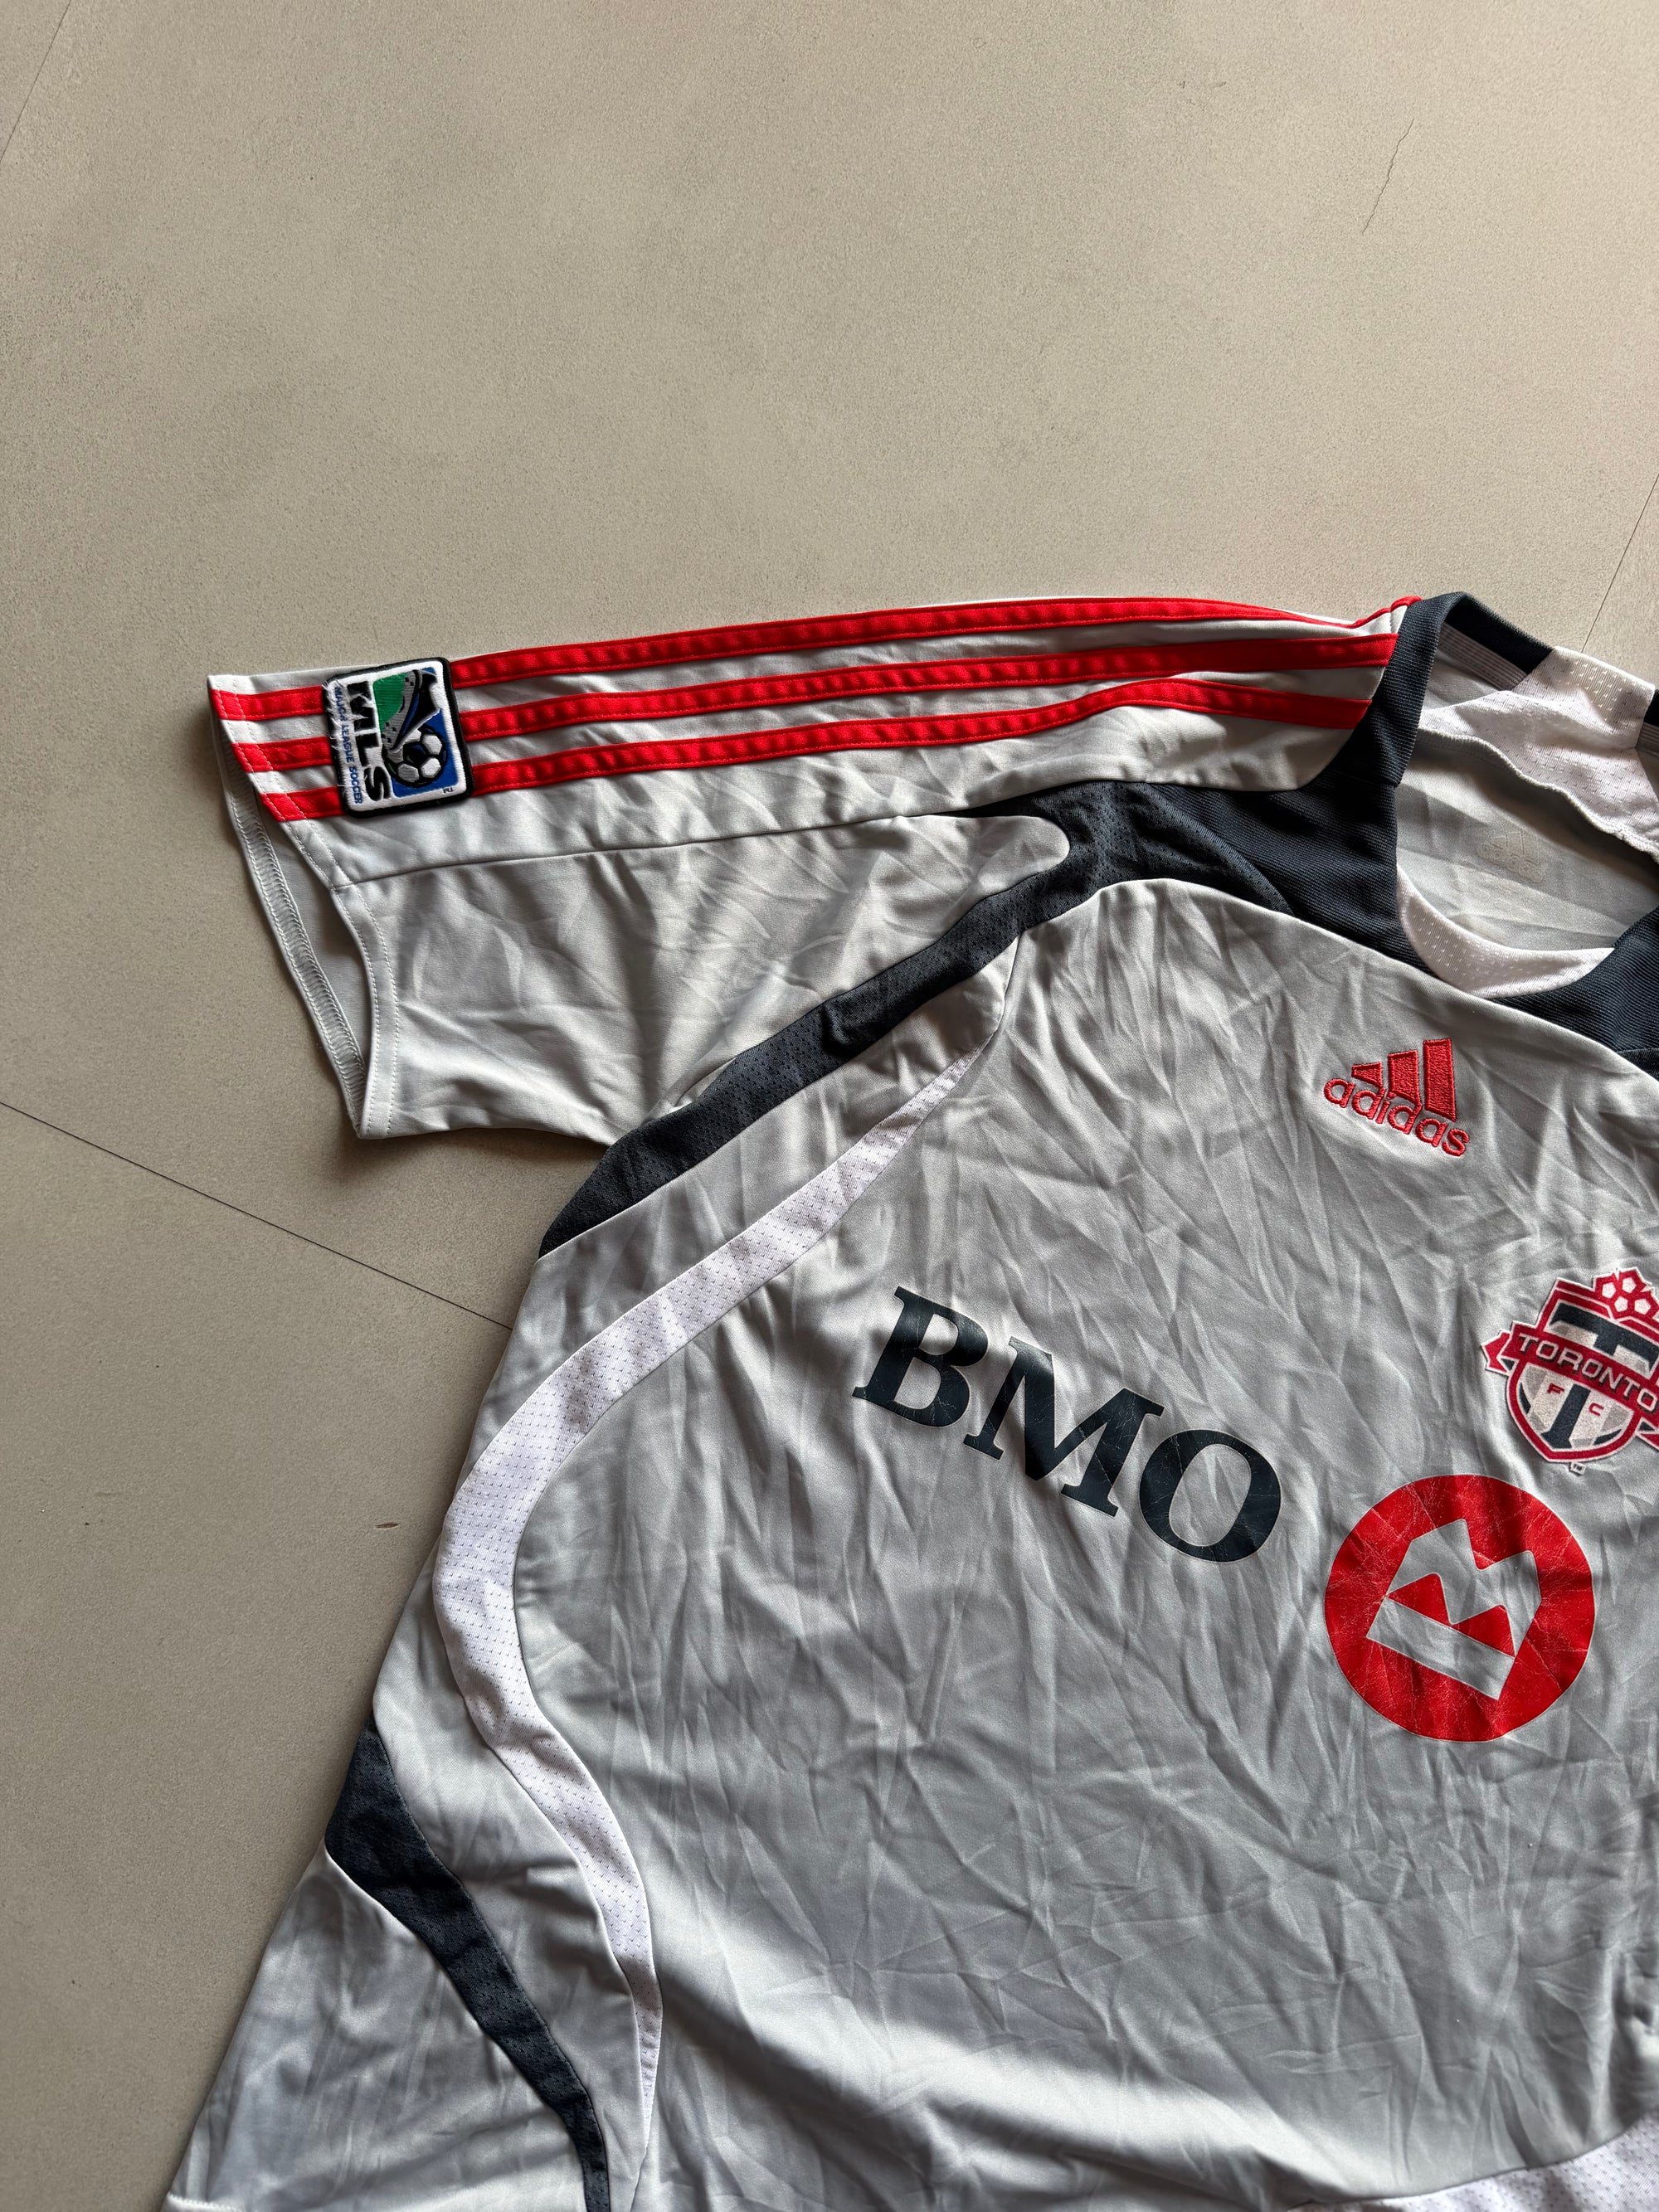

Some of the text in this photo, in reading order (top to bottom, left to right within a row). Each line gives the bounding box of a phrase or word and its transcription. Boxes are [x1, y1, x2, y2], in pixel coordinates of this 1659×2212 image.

[334, 687, 363, 805] MAJOR LEAGUE SOCCER
[347, 680, 392, 801] MLS
[1323, 1078, 1470, 1157] adidas
[852, 1286, 1282, 1563] BMO
[1518, 1332, 1659, 1414] TORONTO
